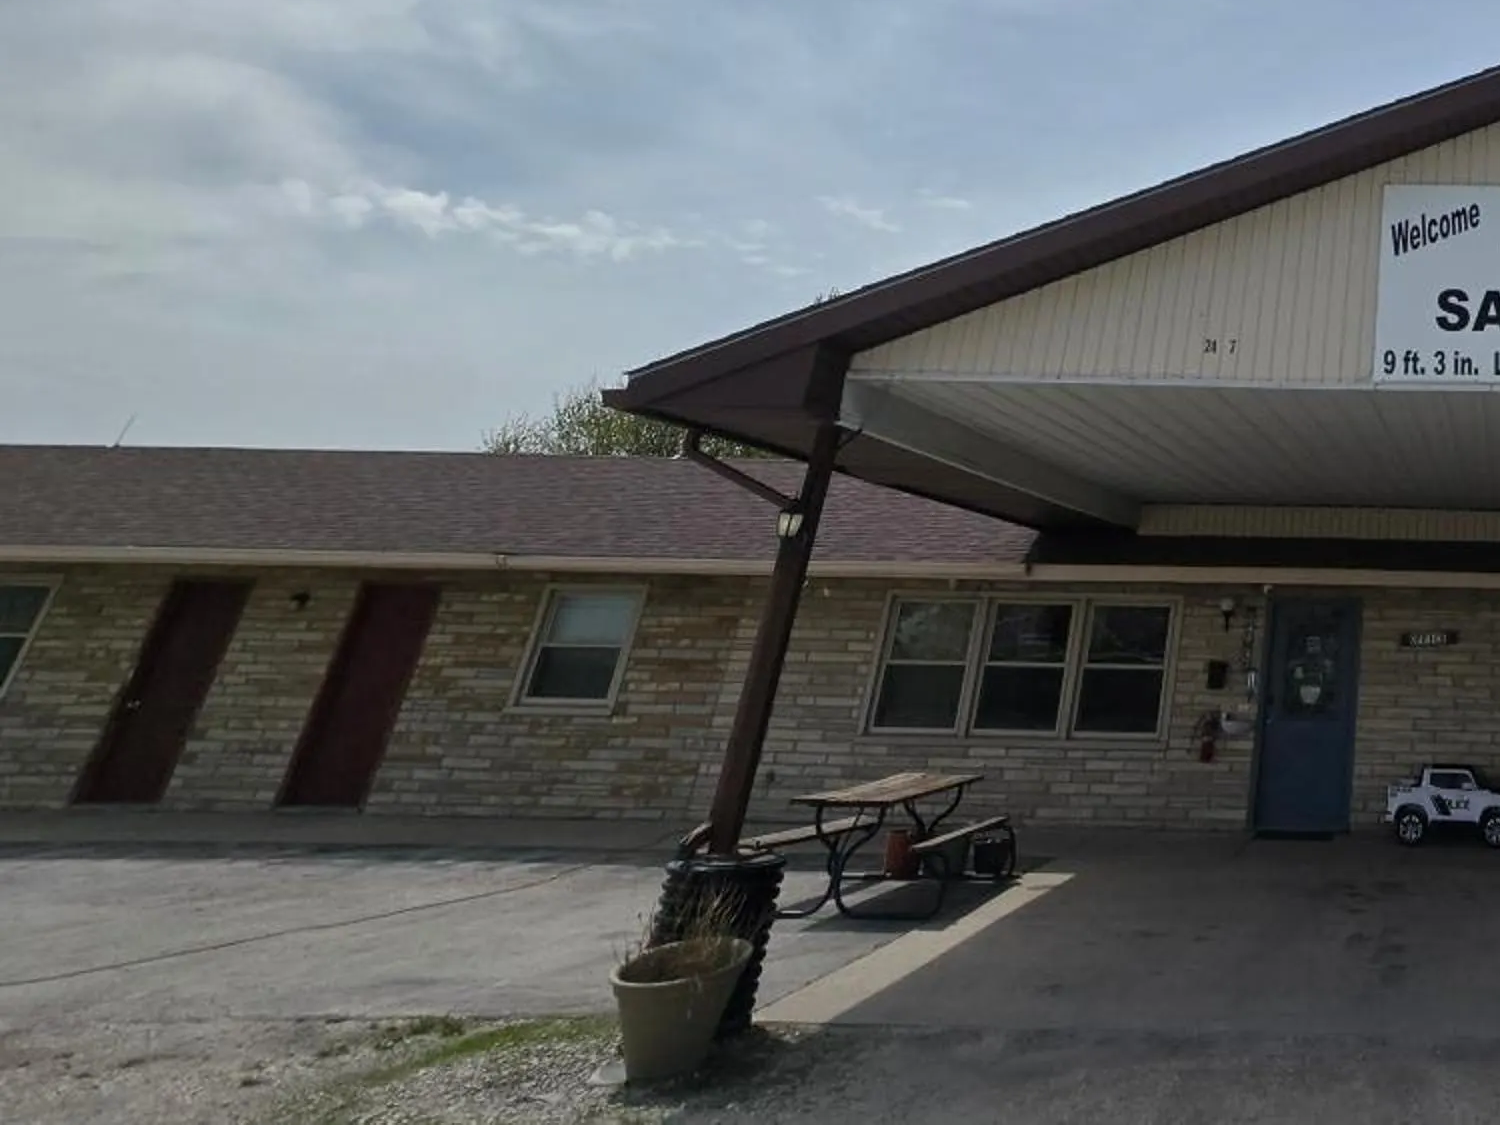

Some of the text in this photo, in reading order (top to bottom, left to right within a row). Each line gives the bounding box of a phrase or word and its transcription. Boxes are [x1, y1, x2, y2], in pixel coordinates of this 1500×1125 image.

[1390, 203, 1481, 257] Welcome
[1383, 350, 1397, 376] 9
[1403, 349, 1426, 376] ft.
[1433, 350, 1446, 376] 3
[1453, 350, 1480, 377] in.
